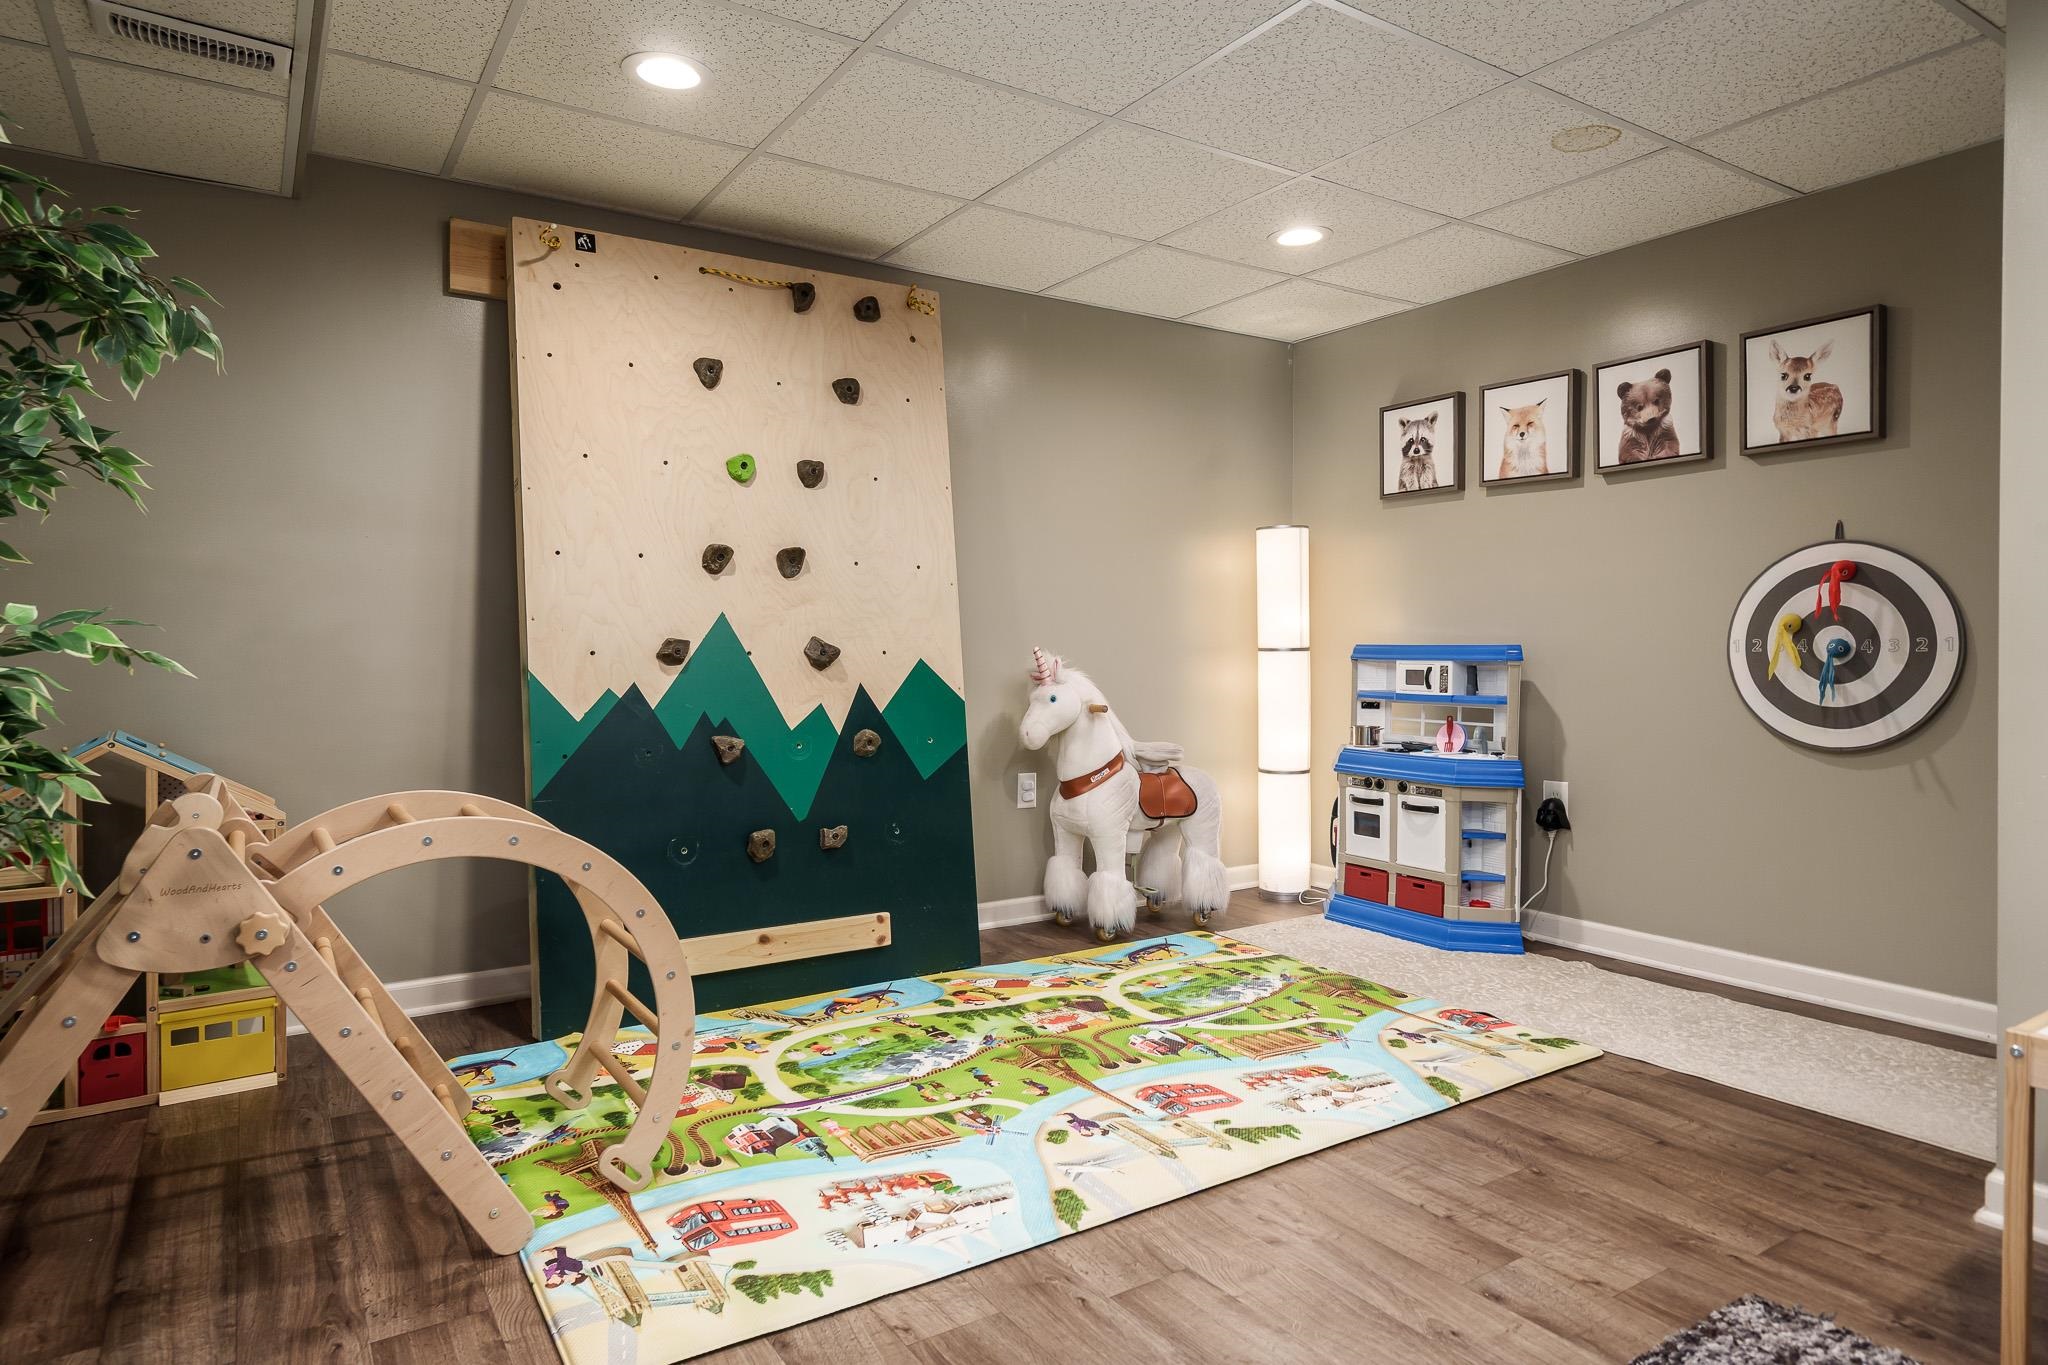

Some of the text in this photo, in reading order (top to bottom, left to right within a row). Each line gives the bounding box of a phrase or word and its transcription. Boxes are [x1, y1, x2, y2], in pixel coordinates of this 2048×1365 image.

[1733, 639, 1741, 653] 1
[1751, 638, 1763, 653] 2
[1797, 638, 1808, 653] 4
[1860, 638, 1874, 654] 4
[1888, 638, 1901, 652] 3
[1915, 637, 1929, 652] 2
[1944, 636, 1954, 652] 1
[160, 883, 242, 897] WoodAndHearts
